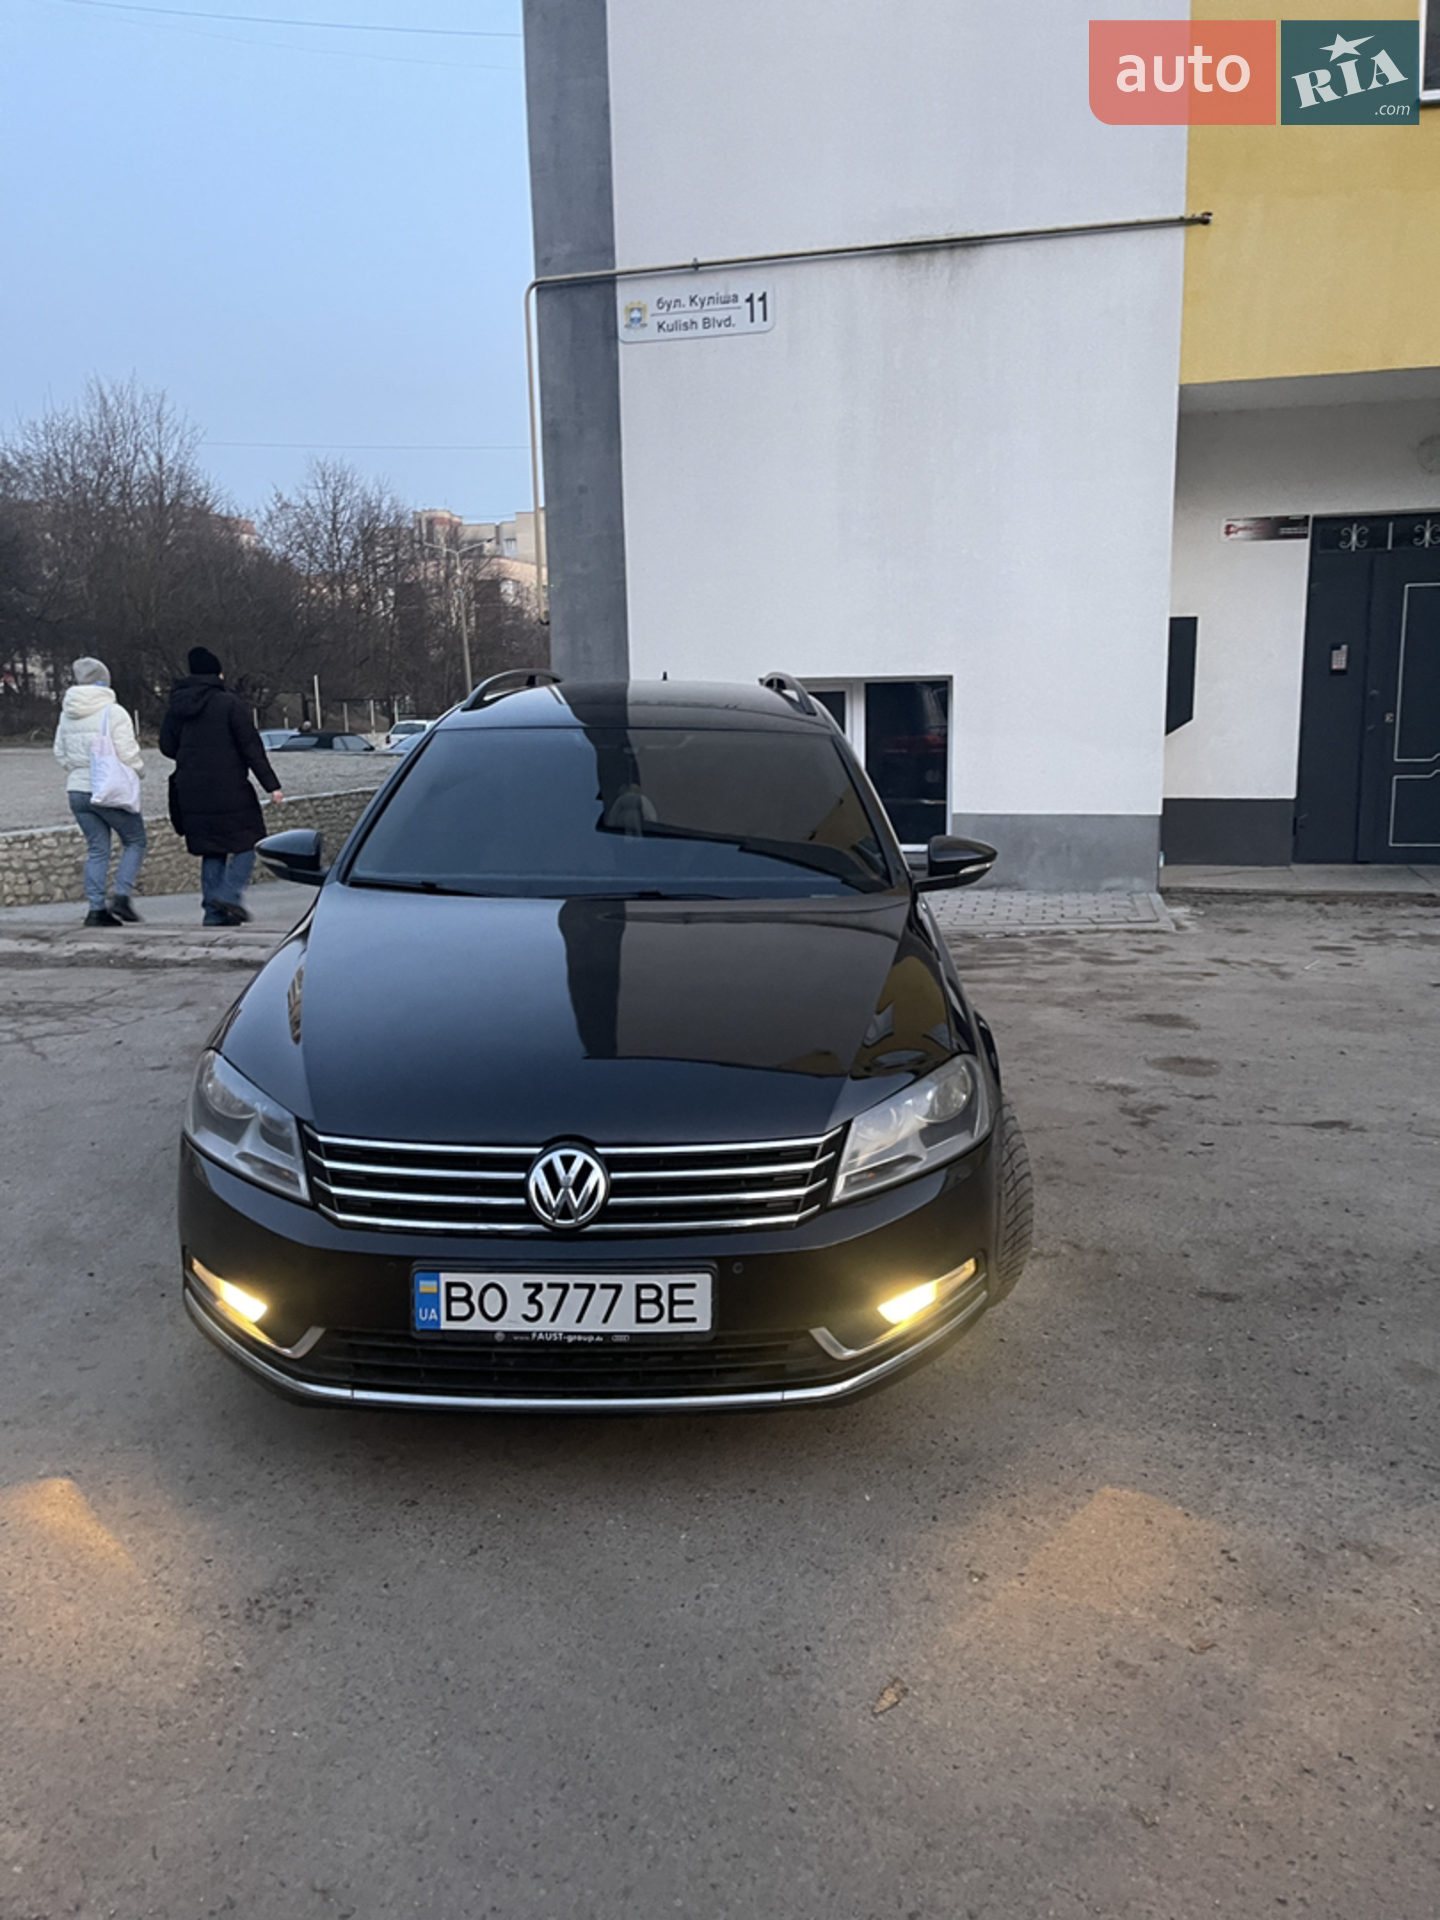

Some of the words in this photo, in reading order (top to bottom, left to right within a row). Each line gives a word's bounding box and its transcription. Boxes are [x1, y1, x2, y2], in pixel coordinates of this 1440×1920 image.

[656, 297, 686, 312] бул.
[689, 292, 739, 309] Куліша
[745, 291, 768, 323] 11
[657, 316, 698, 333] Kulish
[702, 316, 736, 330] Blvd.
[445, 1281, 508, 1323] BO
[521, 1282, 623, 1324] 3777
[635, 1282, 697, 1324] BE
[419, 1308, 438, 1321] UA
